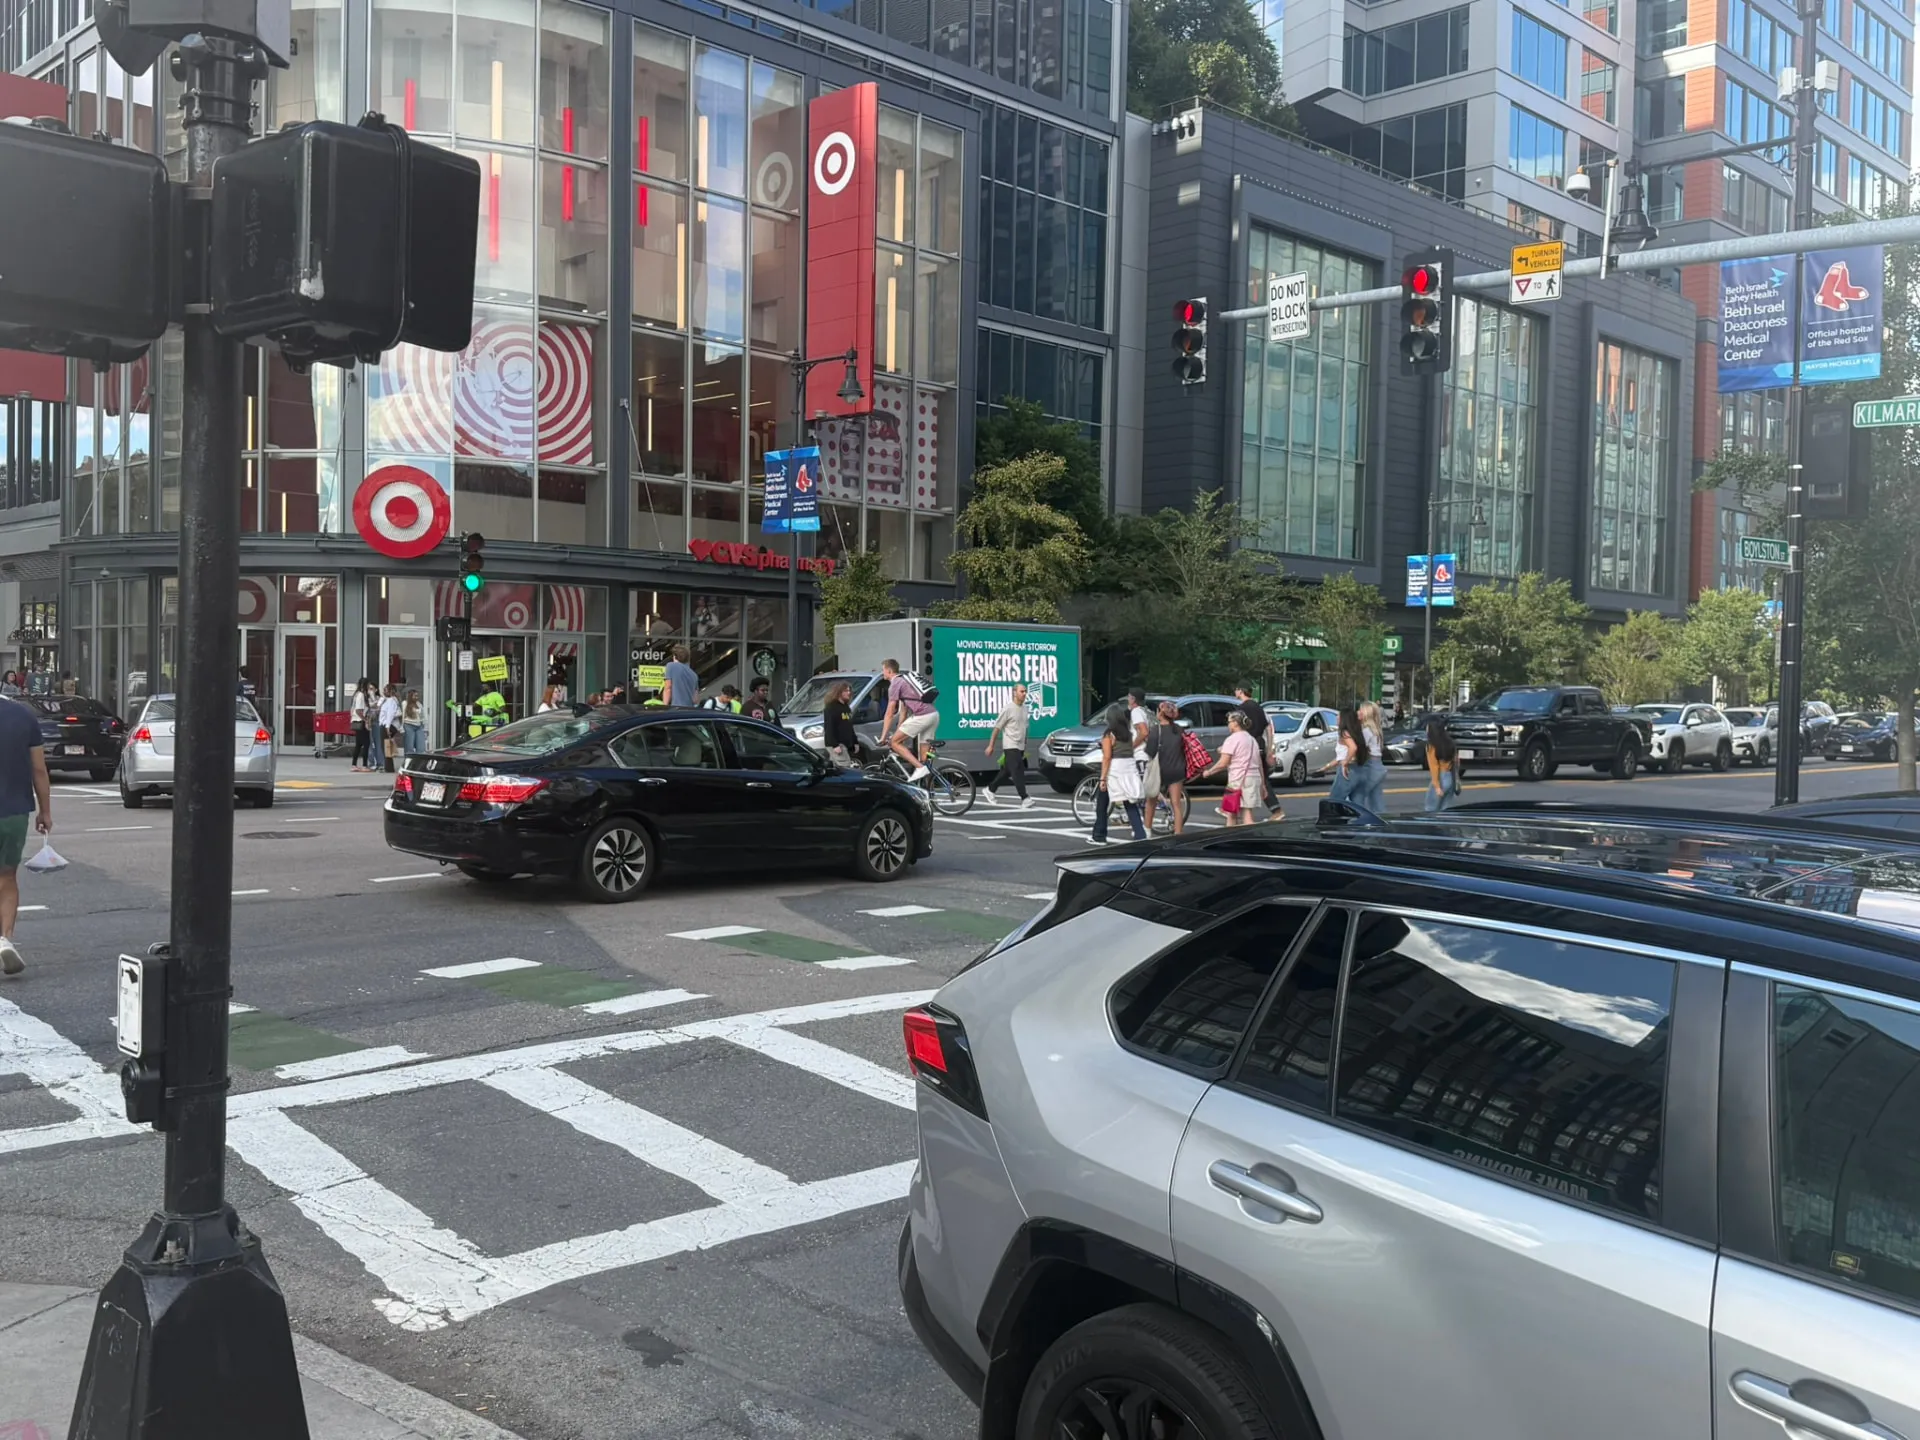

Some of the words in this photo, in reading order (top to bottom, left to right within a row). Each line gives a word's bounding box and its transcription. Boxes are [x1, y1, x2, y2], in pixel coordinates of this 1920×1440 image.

[1531, 248, 1559, 258] TURNING
[1530, 258, 1559, 268] VEHICLES
[1271, 286, 1284, 300] DO
[1287, 280, 1305, 298] NOT
[1726, 285, 1744, 295] Beth
[1746, 281, 1768, 291] Israel
[1726, 294, 1749, 303] Lahey
[1751, 289, 1779, 299] Health
[1272, 302, 1306, 321] BLOCK
[1725, 304, 1751, 318] Beth
[1754, 299, 1785, 315] Israel
[1724, 317, 1788, 332] Deaconess
[1808, 328, 1838, 339] Official
[1840, 324, 1874, 336] hospital
[1724, 330, 1770, 347] Medical
[1807, 340, 1816, 348] of
[1818, 339, 1832, 347] the
[1834, 337, 1851, 345] Red
[1853, 335, 1868, 343] Sox
[1724, 348, 1763, 361] Center
[1805, 362, 1828, 370] MAYOR
[1829, 359, 1860, 368] MICHELLE
[1856, 402, 1920, 424] KILMAR
[710, 540, 758, 567] CVS
[1744, 540, 1780, 560] BOYLSTON
[957, 640, 983, 649] MOVING
[984, 641, 1009, 650] TRUCKS
[1011, 642, 1026, 650] FEAR
[1027, 642, 1058, 651] STORROW
[631, 648, 666, 661] order
[957, 652, 1021, 682] TASKERS
[1024, 655, 1058, 682] FEAR
[958, 685, 1013, 715] NOTHIN
